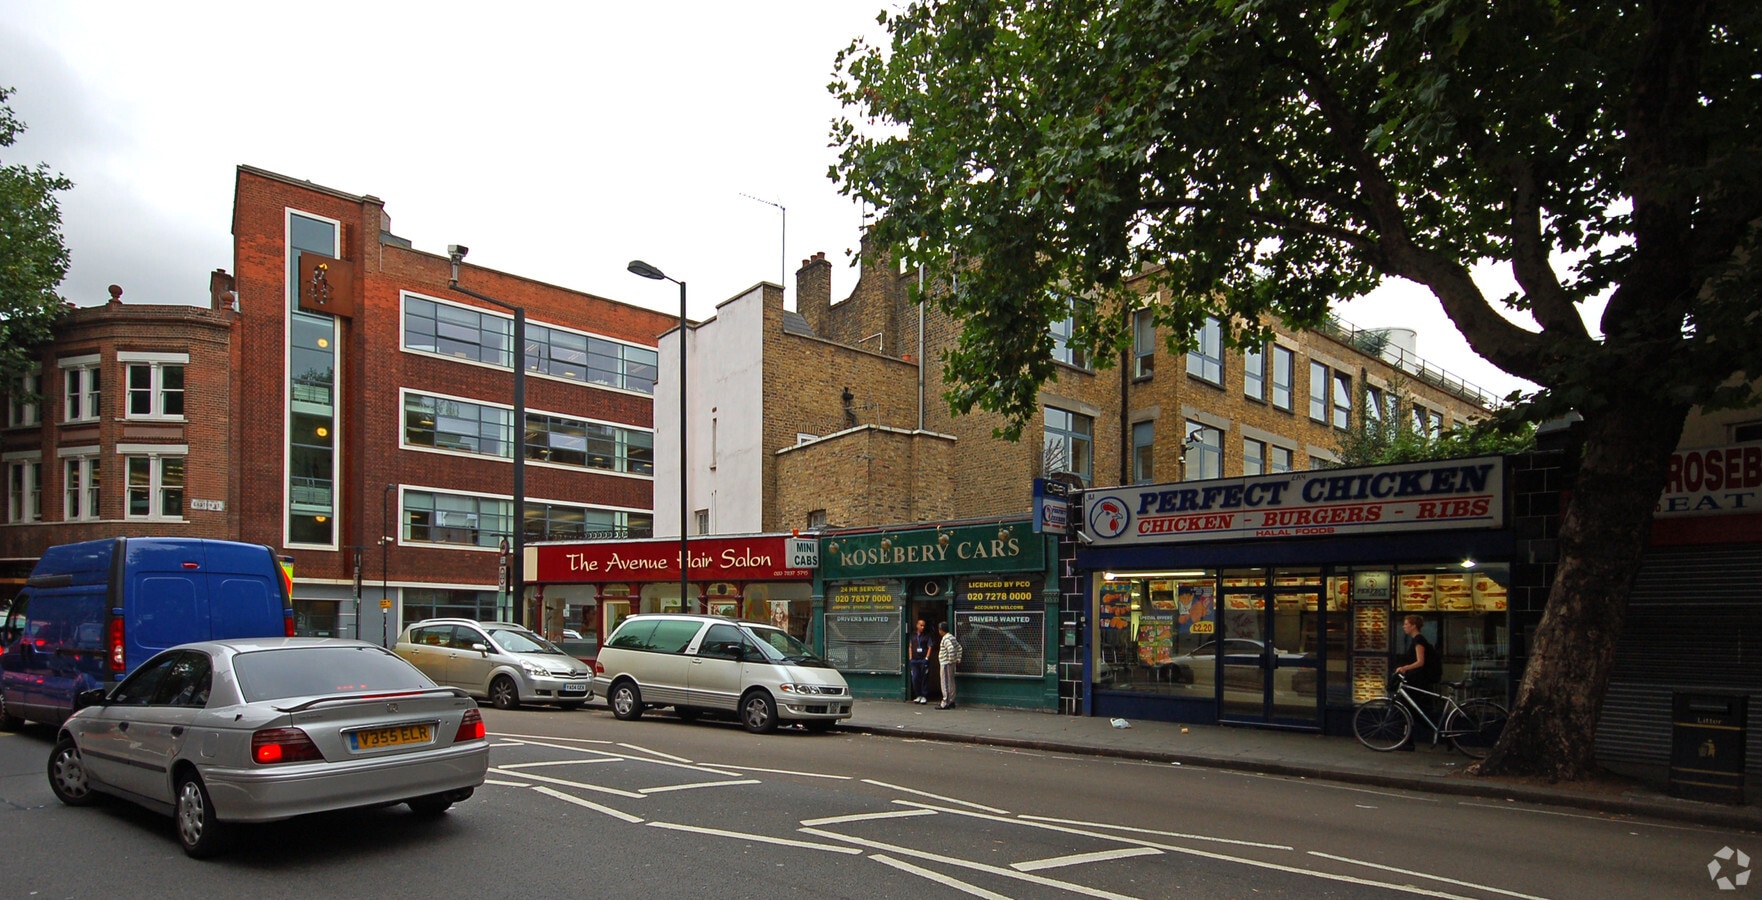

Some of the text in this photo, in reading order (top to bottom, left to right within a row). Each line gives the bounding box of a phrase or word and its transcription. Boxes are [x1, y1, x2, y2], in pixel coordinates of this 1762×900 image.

[1136, 464, 1495, 515] PERFECT CHICKEN
[1666, 493, 1755, 512] EAT
[1137, 514, 1235, 534] CHICKEN
[1261, 505, 1383, 527] BURGERS
[1415, 499, 1490, 519] RIBS
[1295, 527, 1335, 535] FOODS
[796, 542, 815, 553] MINI
[840, 538, 1020, 567] ROSEBERY CARS
[566, 547, 772, 572] The Avenue Hair Salon
[794, 555, 818, 566] CABS
[835, 594, 892, 603] 020 7837 0000
[985, 592, 1007, 600] 7278
[1009, 592, 1032, 600] 0000
[1192, 623, 1213, 632] £2.20
[1697, 716, 1723, 725] Litter
[360, 725, 428, 746] V355 ELR
